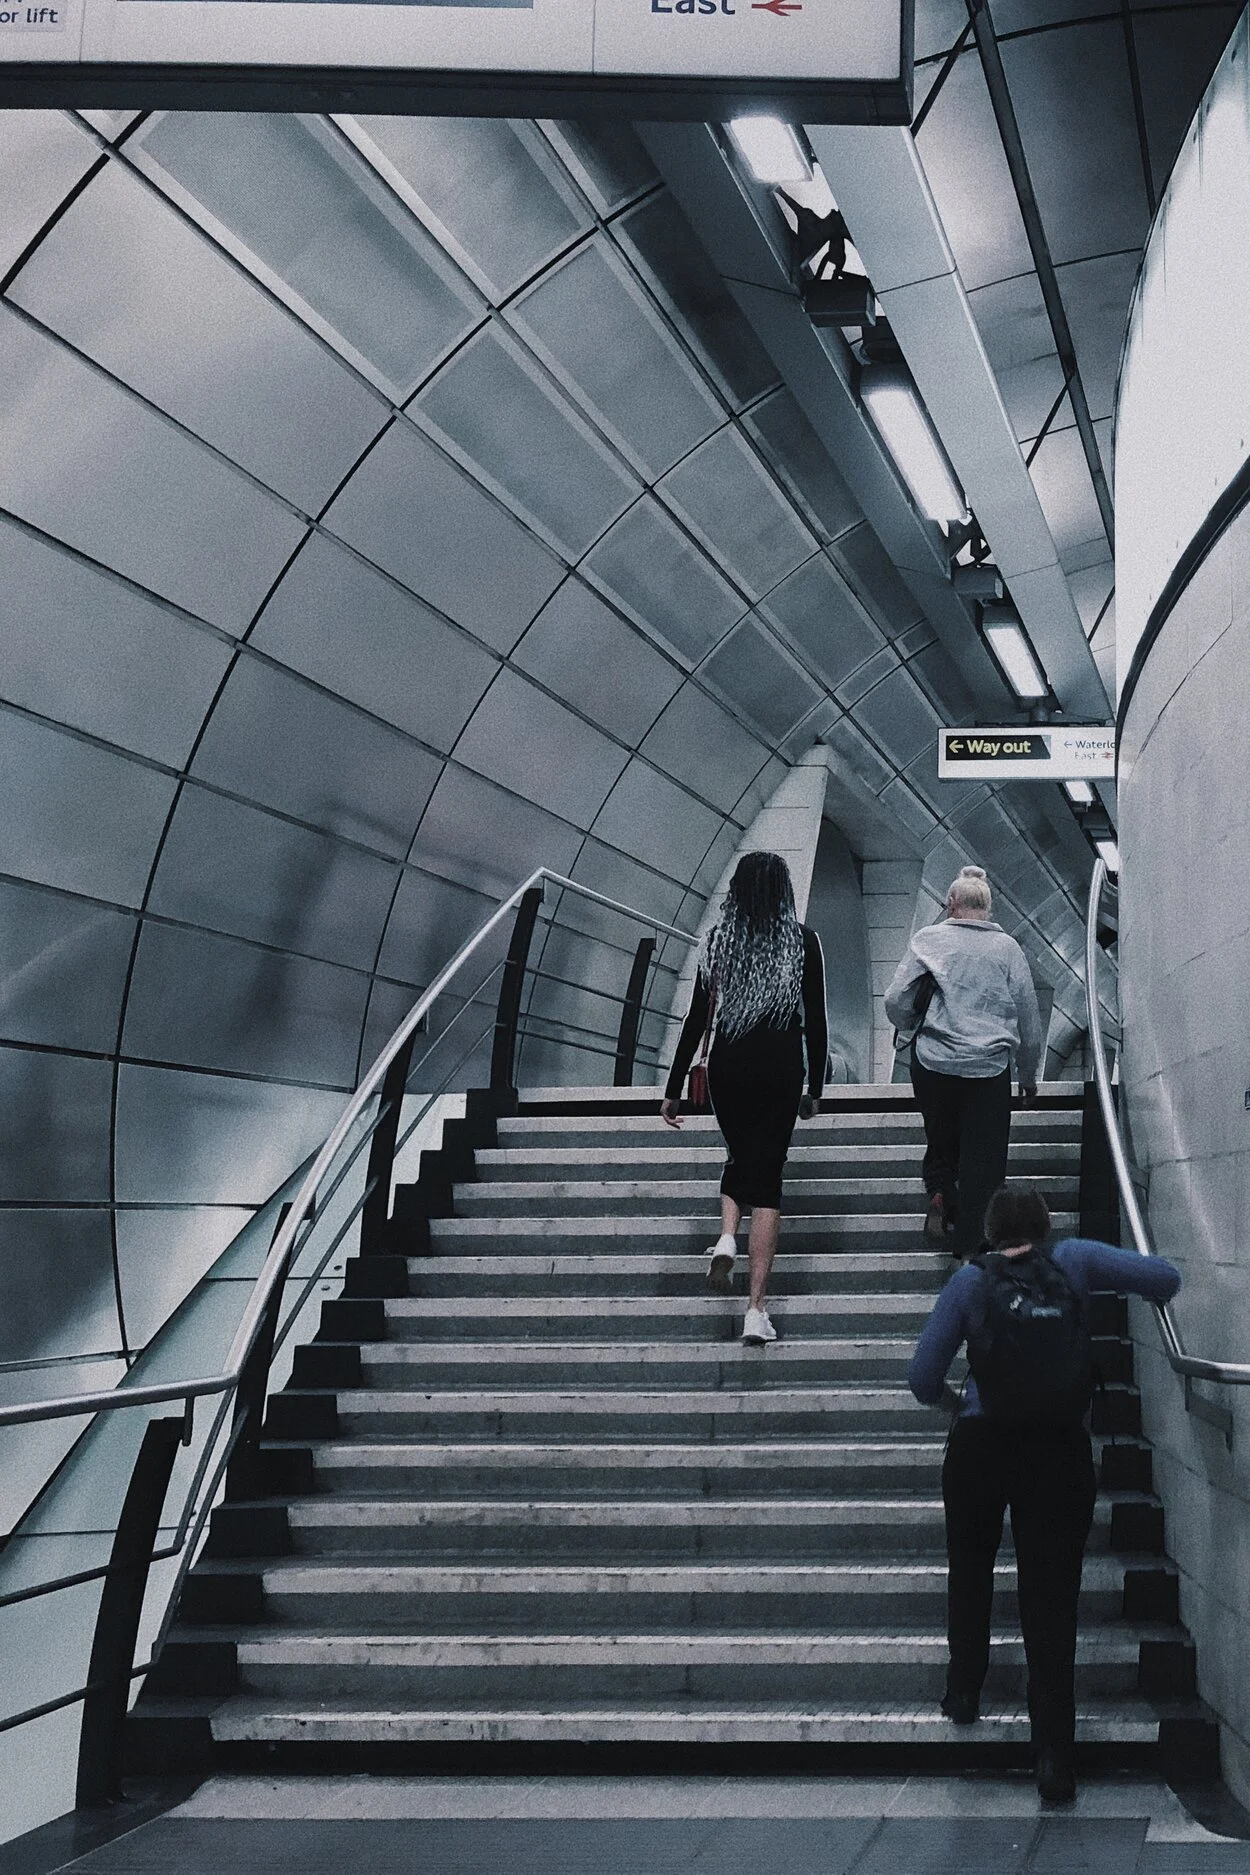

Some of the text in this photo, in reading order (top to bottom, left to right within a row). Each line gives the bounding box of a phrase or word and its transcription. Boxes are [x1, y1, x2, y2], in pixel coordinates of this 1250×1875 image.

[26, 8, 59, 23] lift
[966, 739, 1032, 757] Way out
[1075, 740, 1116, 749] Waterlo
[1074, 751, 1097, 760] East
